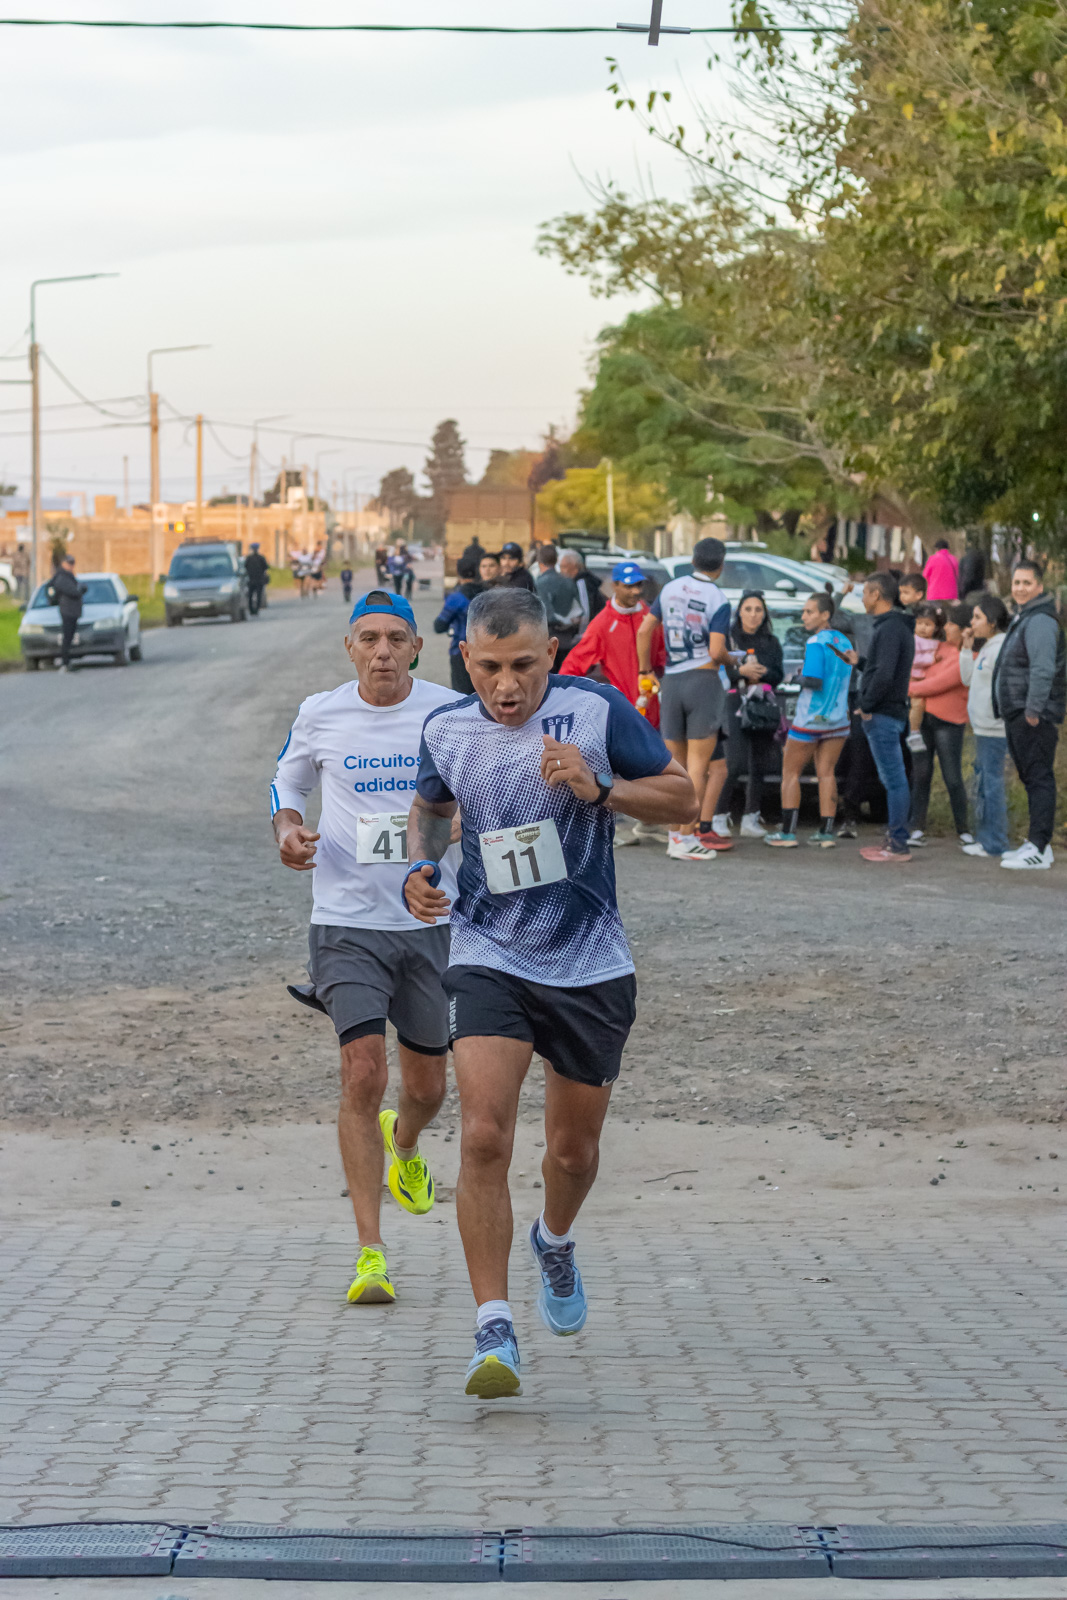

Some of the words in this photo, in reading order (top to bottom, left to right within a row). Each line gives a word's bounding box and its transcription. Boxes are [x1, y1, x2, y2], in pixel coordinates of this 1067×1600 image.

[547, 716, 569, 726] SFC
[343, 753, 422, 769] Circuitos
[354, 777, 416, 792] adidas
[372, 829, 408, 860] 41
[501, 846, 541, 886] 11
